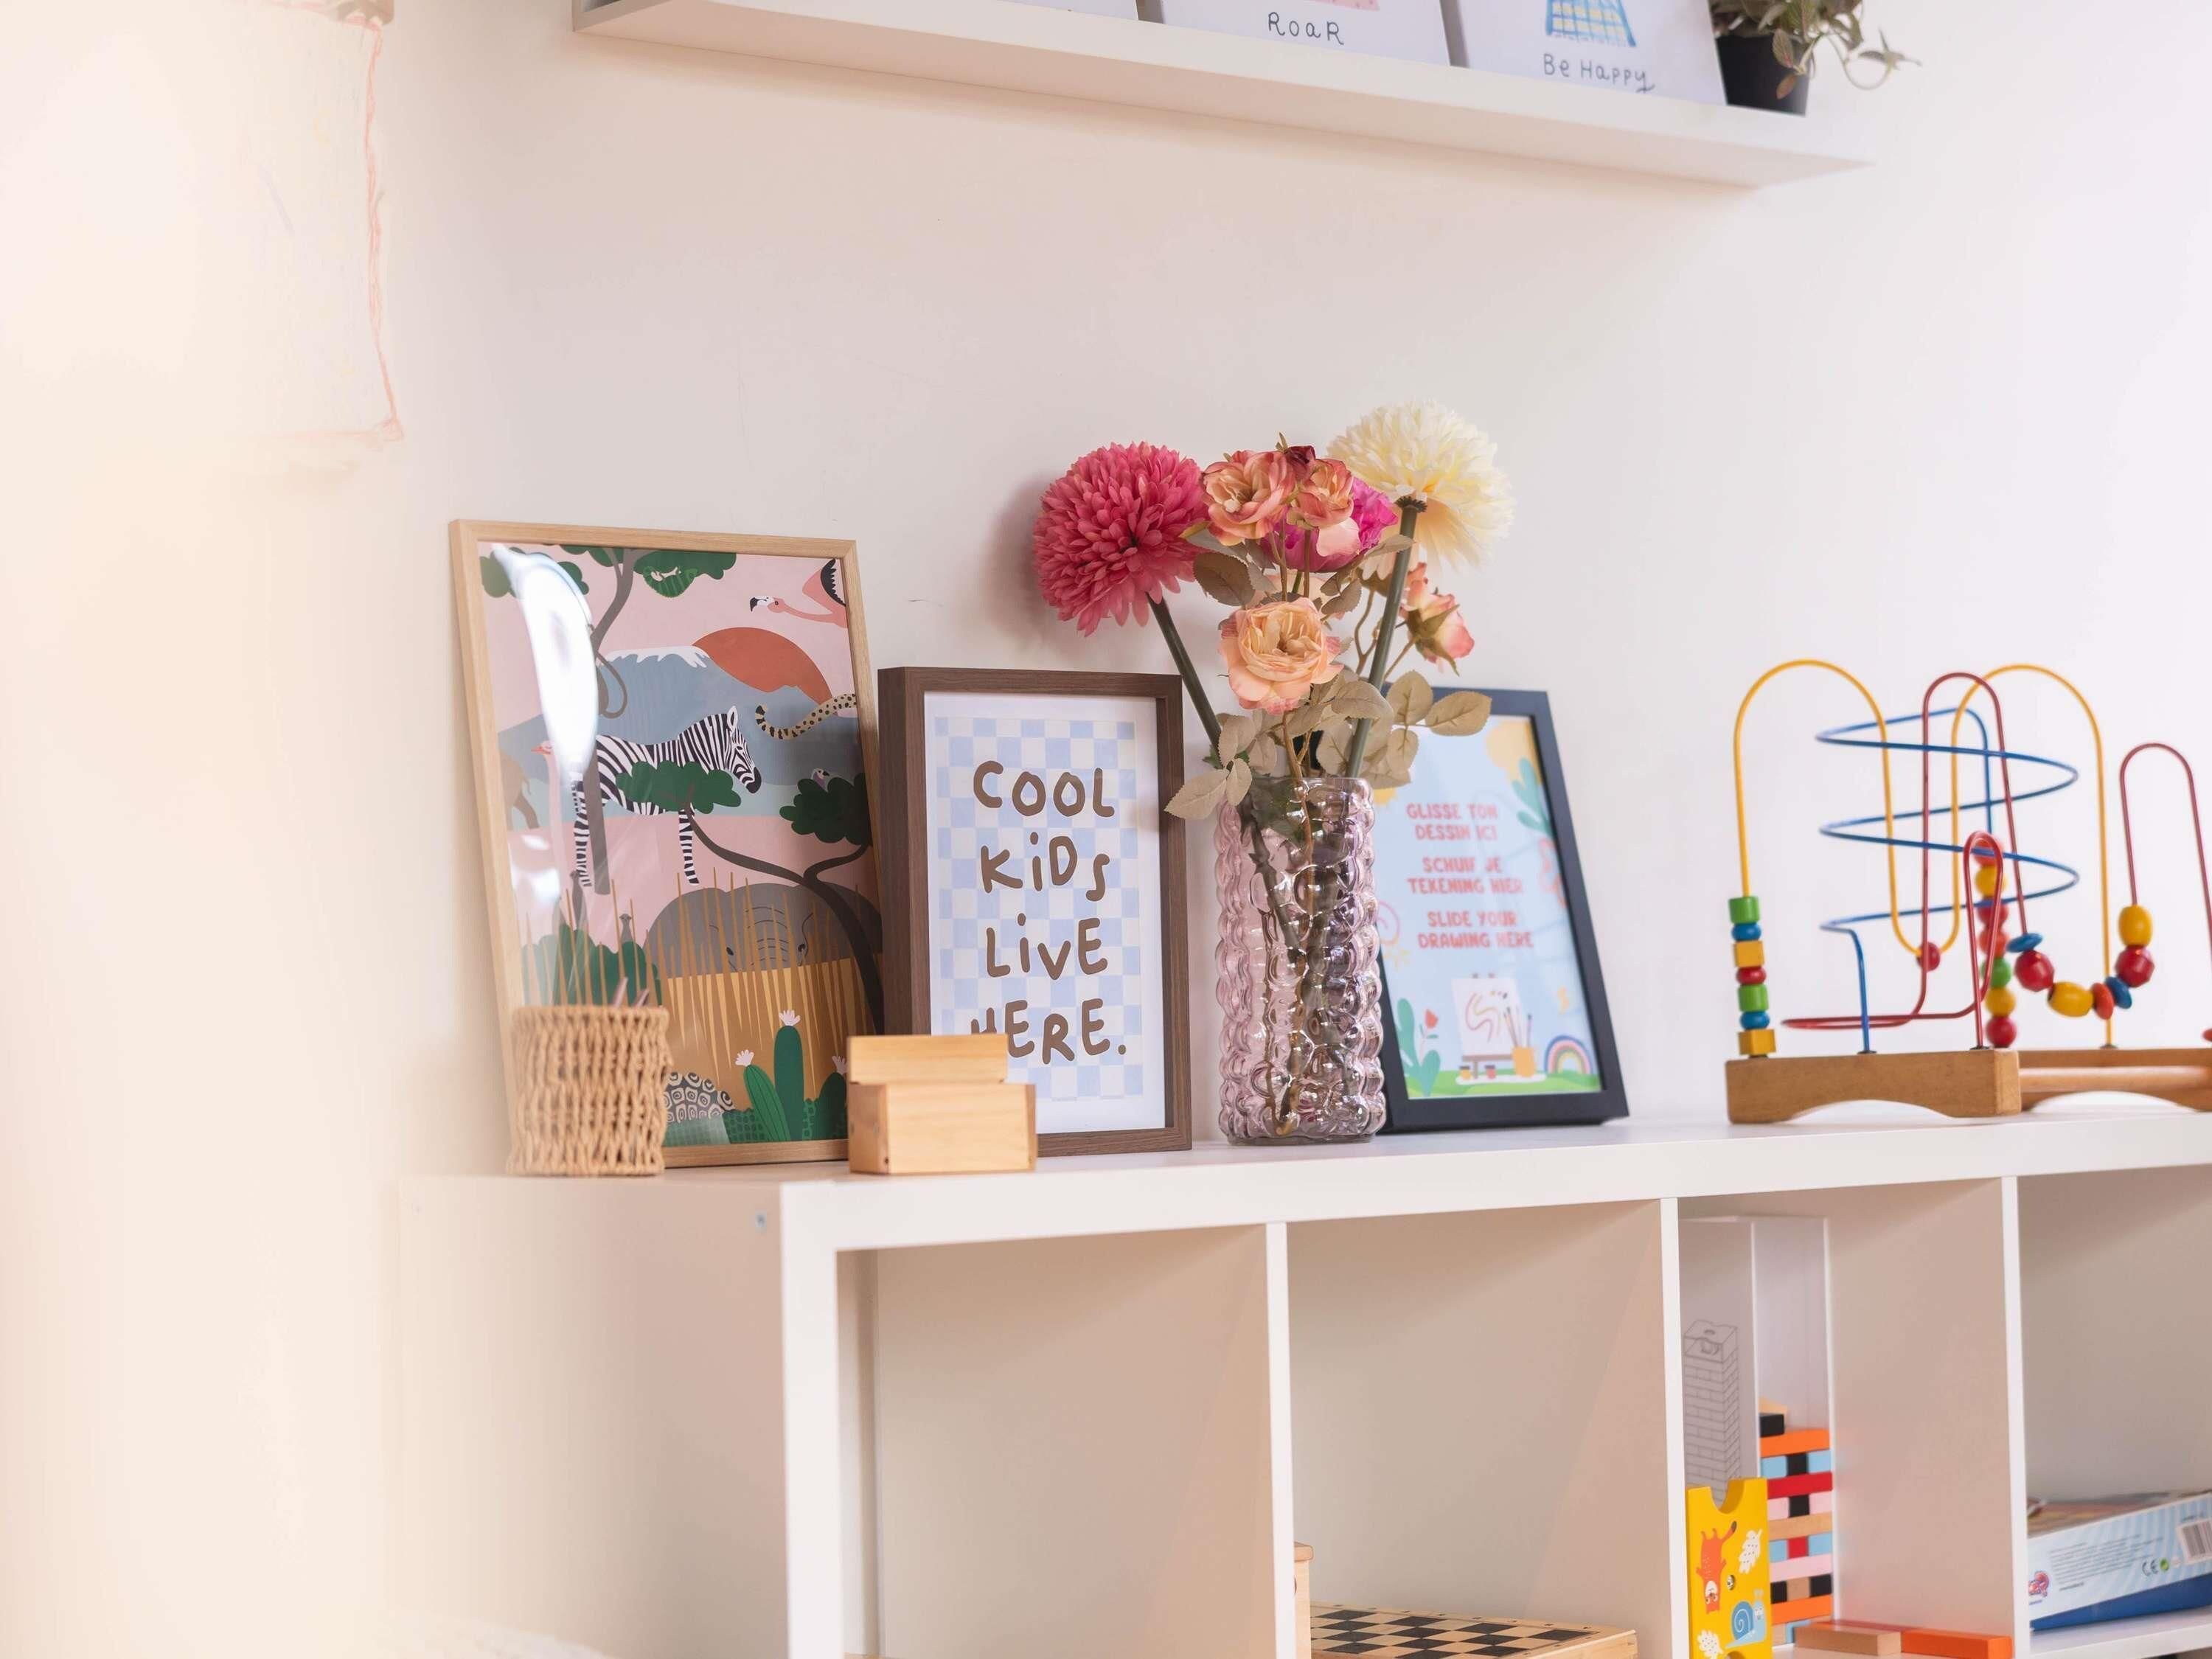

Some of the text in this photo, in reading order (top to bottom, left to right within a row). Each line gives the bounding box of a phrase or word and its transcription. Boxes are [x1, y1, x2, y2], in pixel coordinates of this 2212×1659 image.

[1543, 52, 1656, 94] Be Happy
[973, 760, 1115, 818] COOL
[1406, 801, 1498, 821] GLISSE TON
[1414, 823, 1497, 841] DESSIN ICI
[1406, 876, 1484, 895] TEKENING
[1427, 909, 1518, 928] SLIDE YOUR
[1416, 931, 1535, 950] DRAWING HERE
